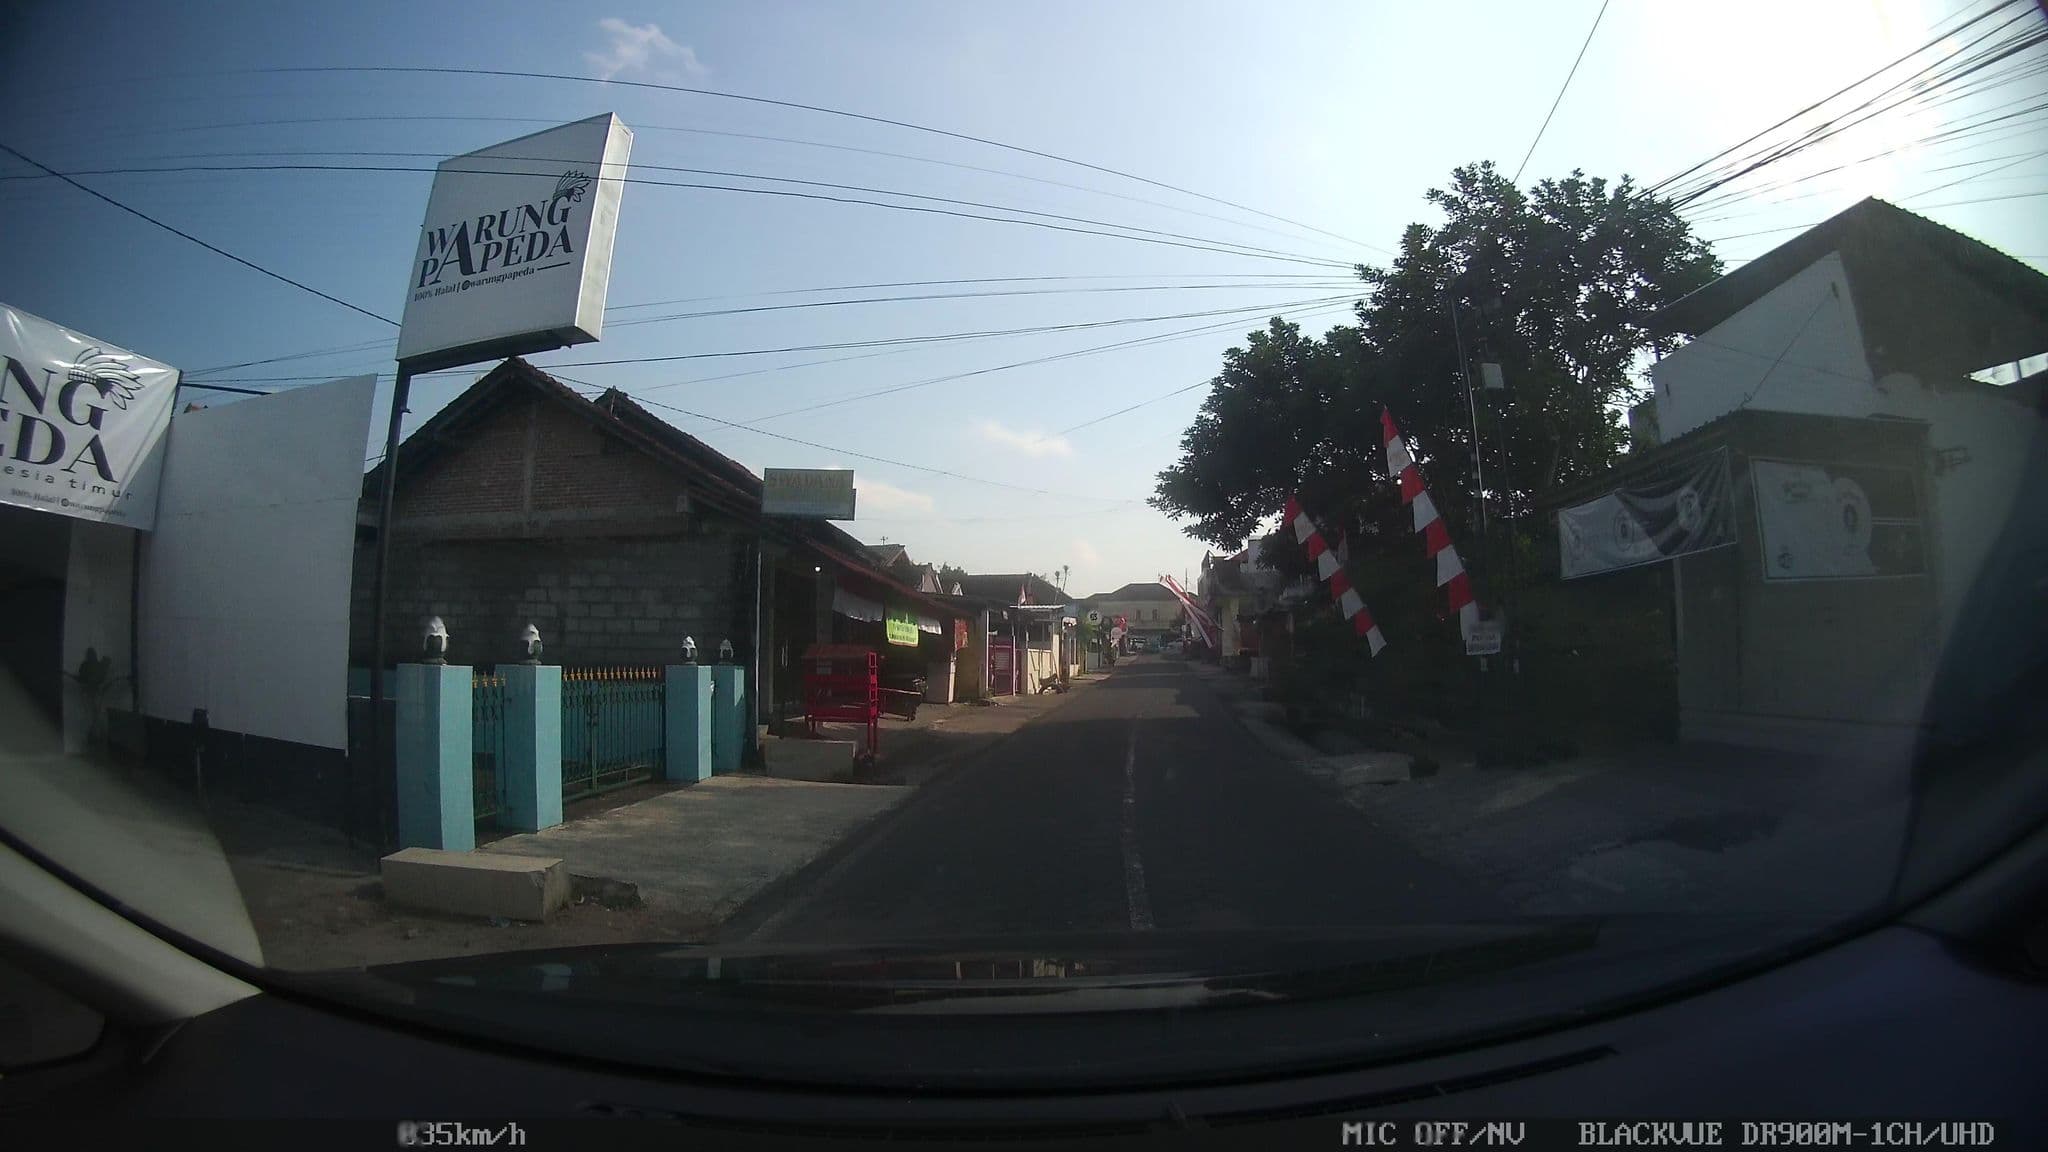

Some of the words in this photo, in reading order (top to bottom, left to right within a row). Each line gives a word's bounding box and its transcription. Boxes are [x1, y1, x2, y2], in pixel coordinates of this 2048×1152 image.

[417, 224, 574, 289] PAPEDA
[428, 196, 572, 271] WARUNG
[69, 478, 134, 500] timur
